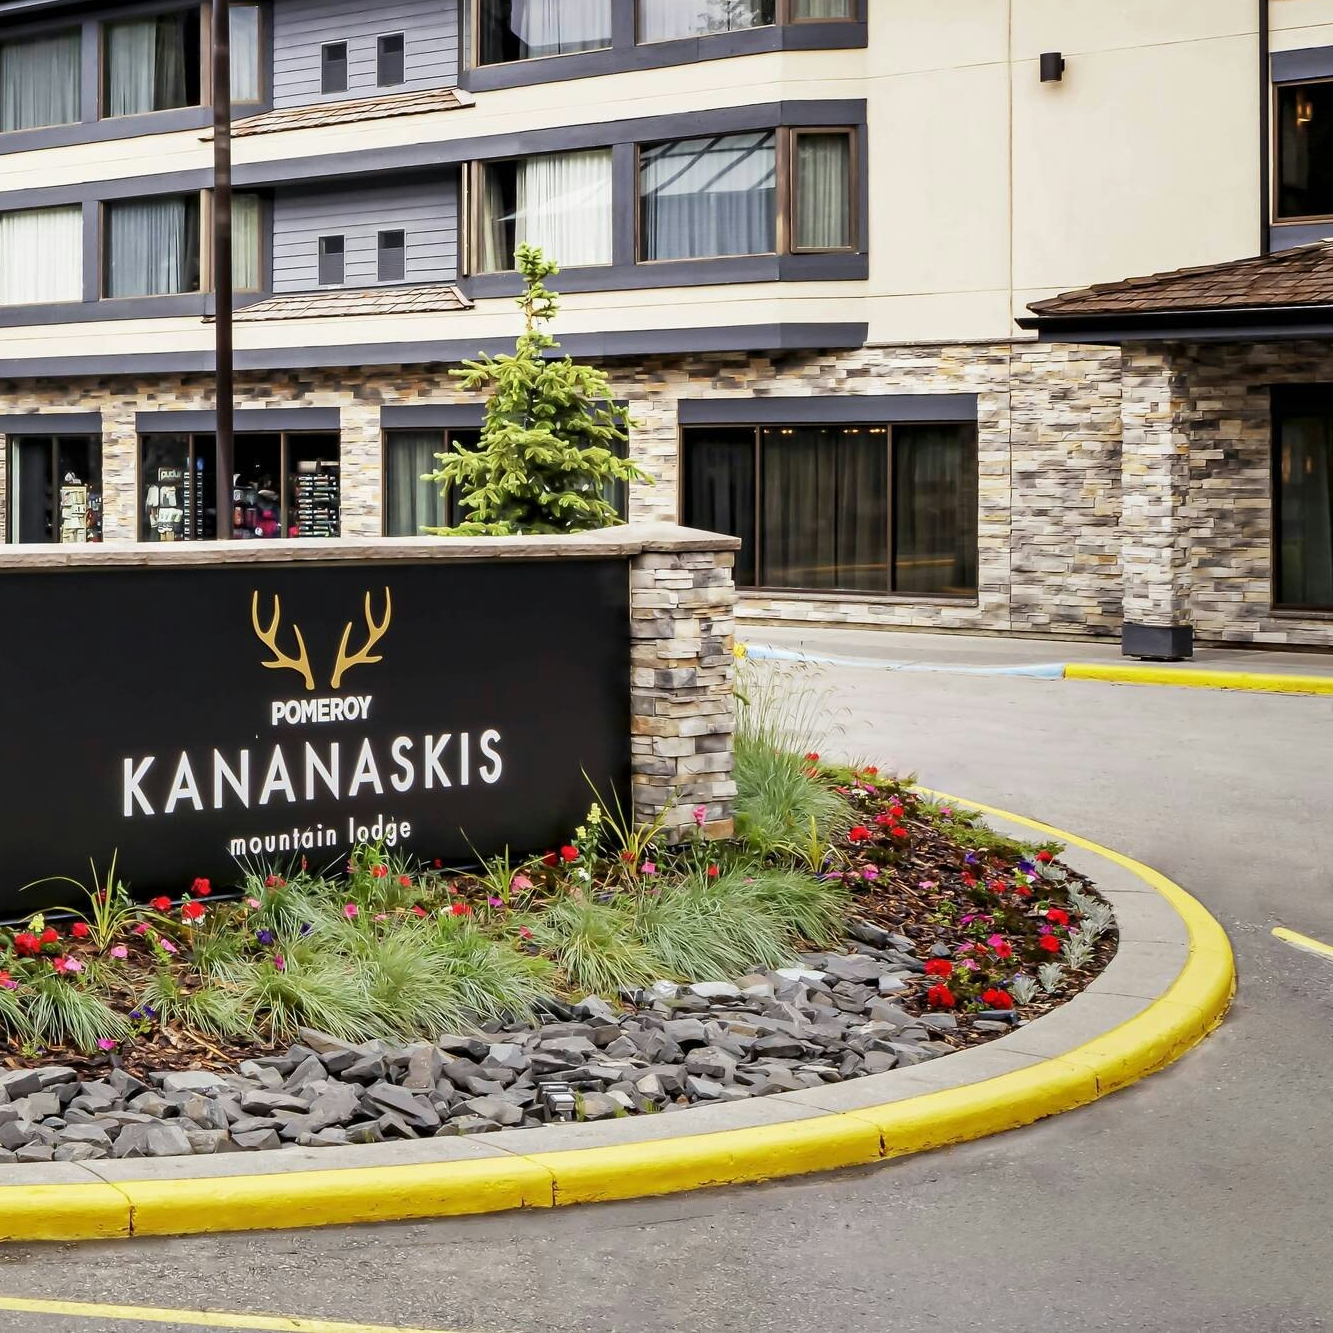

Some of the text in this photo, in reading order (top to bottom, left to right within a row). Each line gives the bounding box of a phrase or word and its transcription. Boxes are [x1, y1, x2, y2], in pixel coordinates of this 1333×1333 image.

[271, 695, 373, 726] POMEROY
[123, 728, 504, 818] KANANASKIS
[230, 813, 412, 856] mountain lodge
